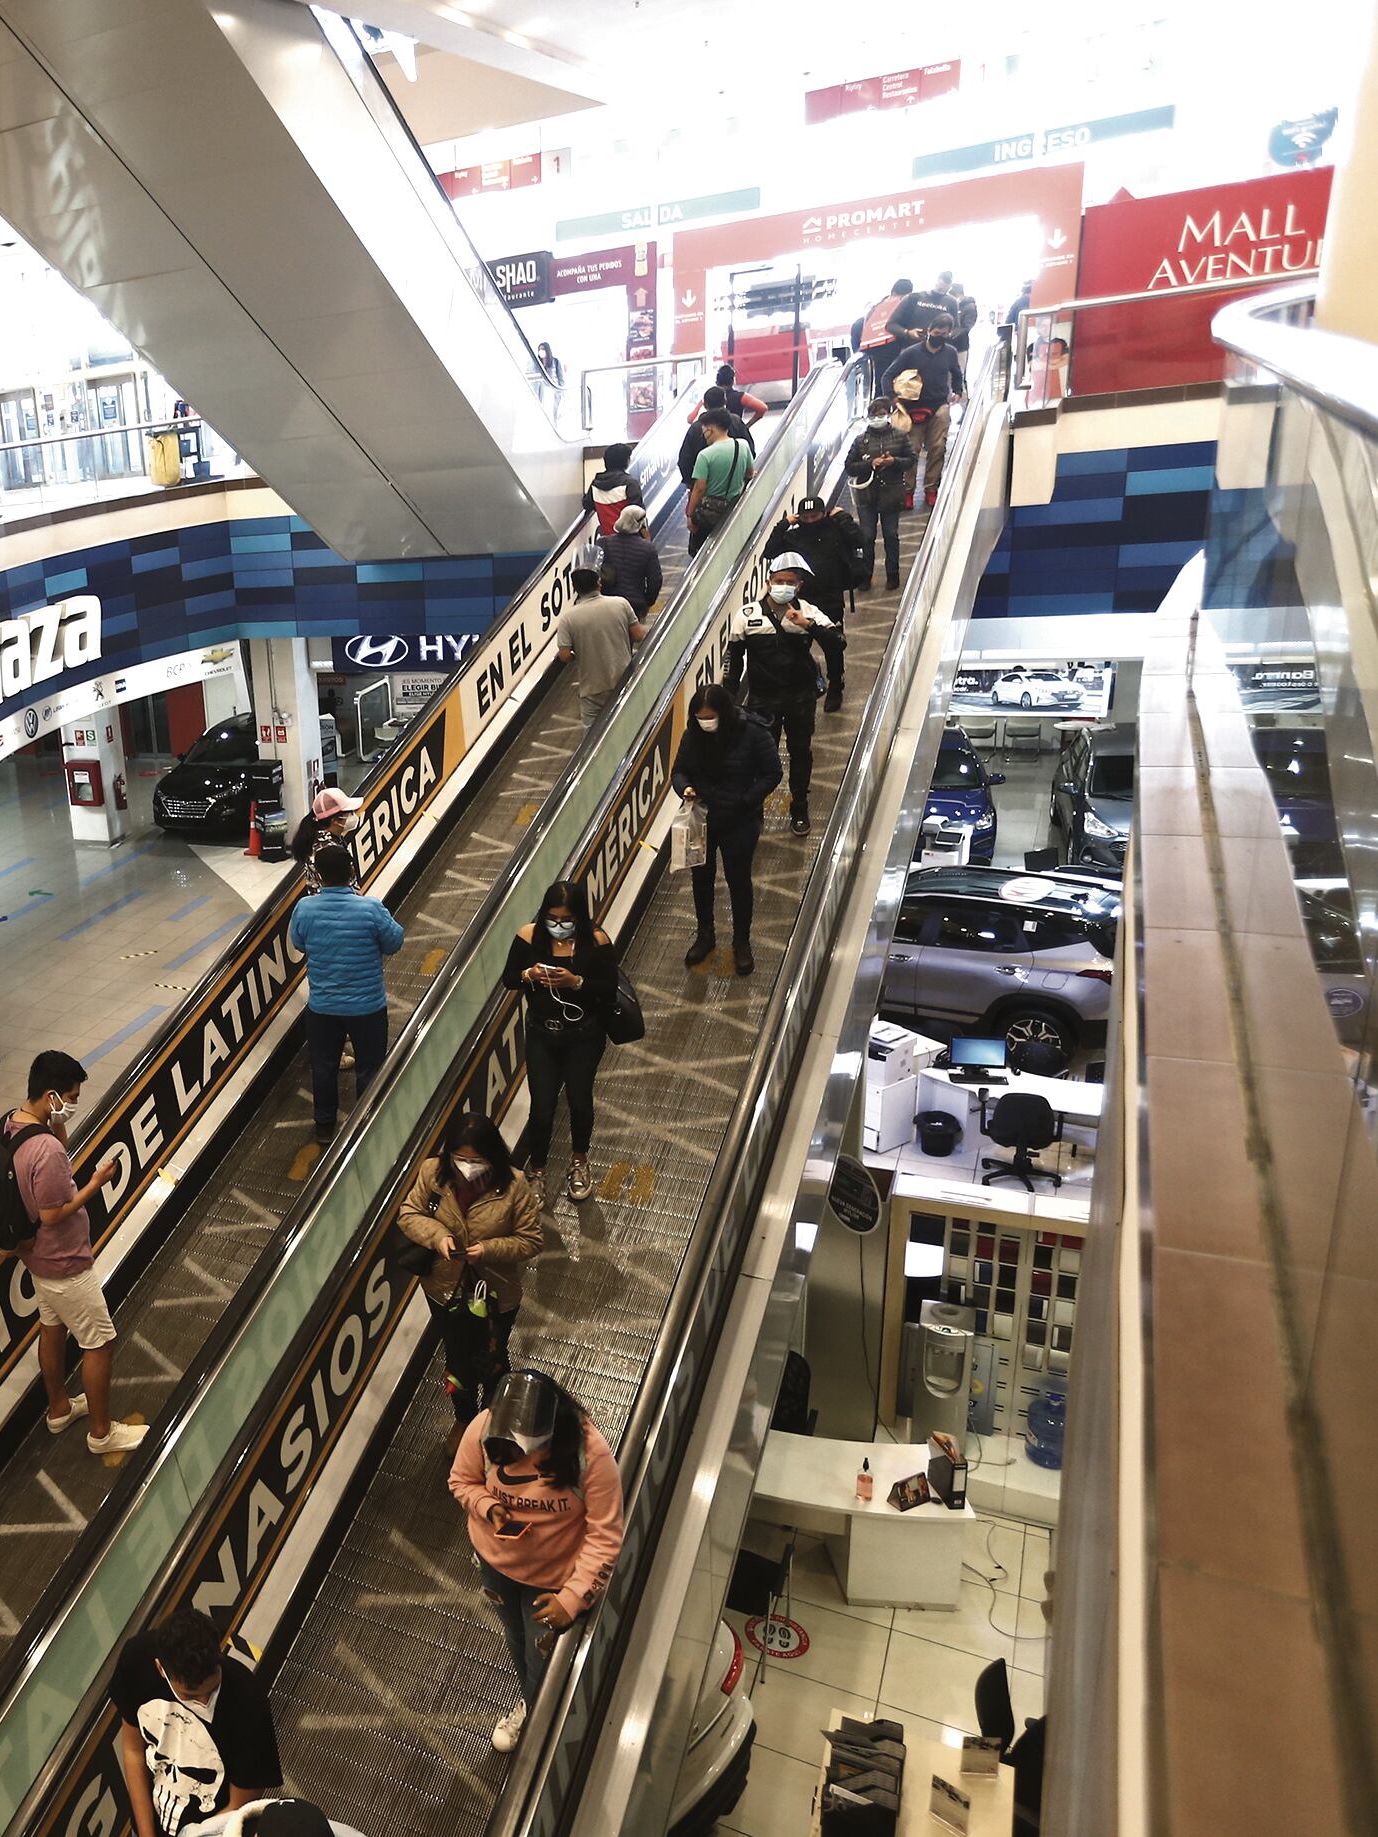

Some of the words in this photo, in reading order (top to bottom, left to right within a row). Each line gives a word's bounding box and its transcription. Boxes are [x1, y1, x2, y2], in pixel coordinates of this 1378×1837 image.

[553, 156, 560, 174] 1
[826, 200, 925, 230] PROMART
[1176, 203, 1307, 254] MALL
[803, 217, 925, 245] HOMECENTER
[495, 260, 537, 293] SHAO
[556, 264, 586, 279] ACOMPAÑA
[586, 263, 599, 274] TUS
[598, 260, 623, 271] PEDIDOS
[576, 275, 588, 284] CON
[419, 634, 480, 662] HY
[402, 684, 429, 692] ELEGIR
[95, 1094, 164, 1214] DE
[477, 654, 505, 719] EN
[508, 622, 532, 676] EL
[493, 1486, 515, 1507] JUST
[558, 1497, 571, 1513] IT.
